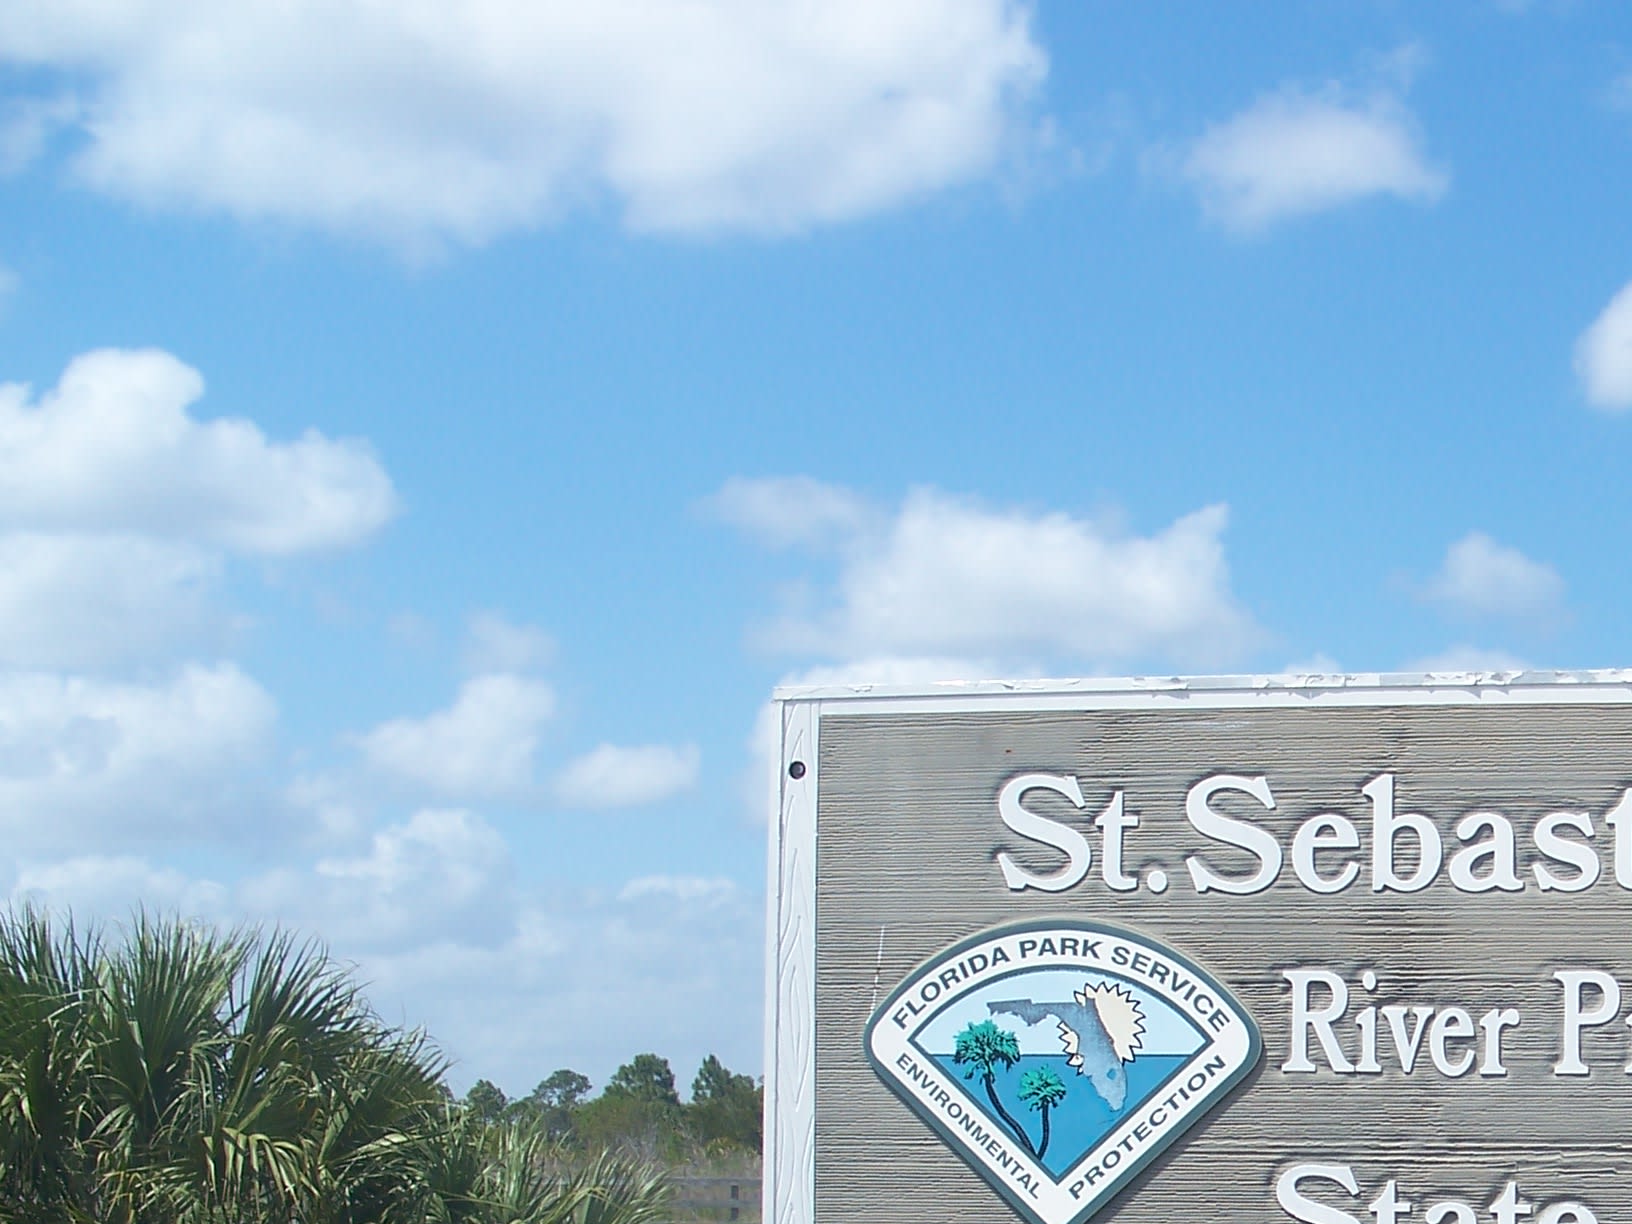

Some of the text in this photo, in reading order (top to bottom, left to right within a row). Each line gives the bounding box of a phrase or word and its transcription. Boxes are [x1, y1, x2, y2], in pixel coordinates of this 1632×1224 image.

[892, 937, 1232, 1033] FLORIDA PARK SERVICE
[1282, 969, 1520, 1076] River
[895, 1052, 1041, 1200] ENVIRONMENTAL
[1068, 1054, 1227, 1200] PROTECTION
